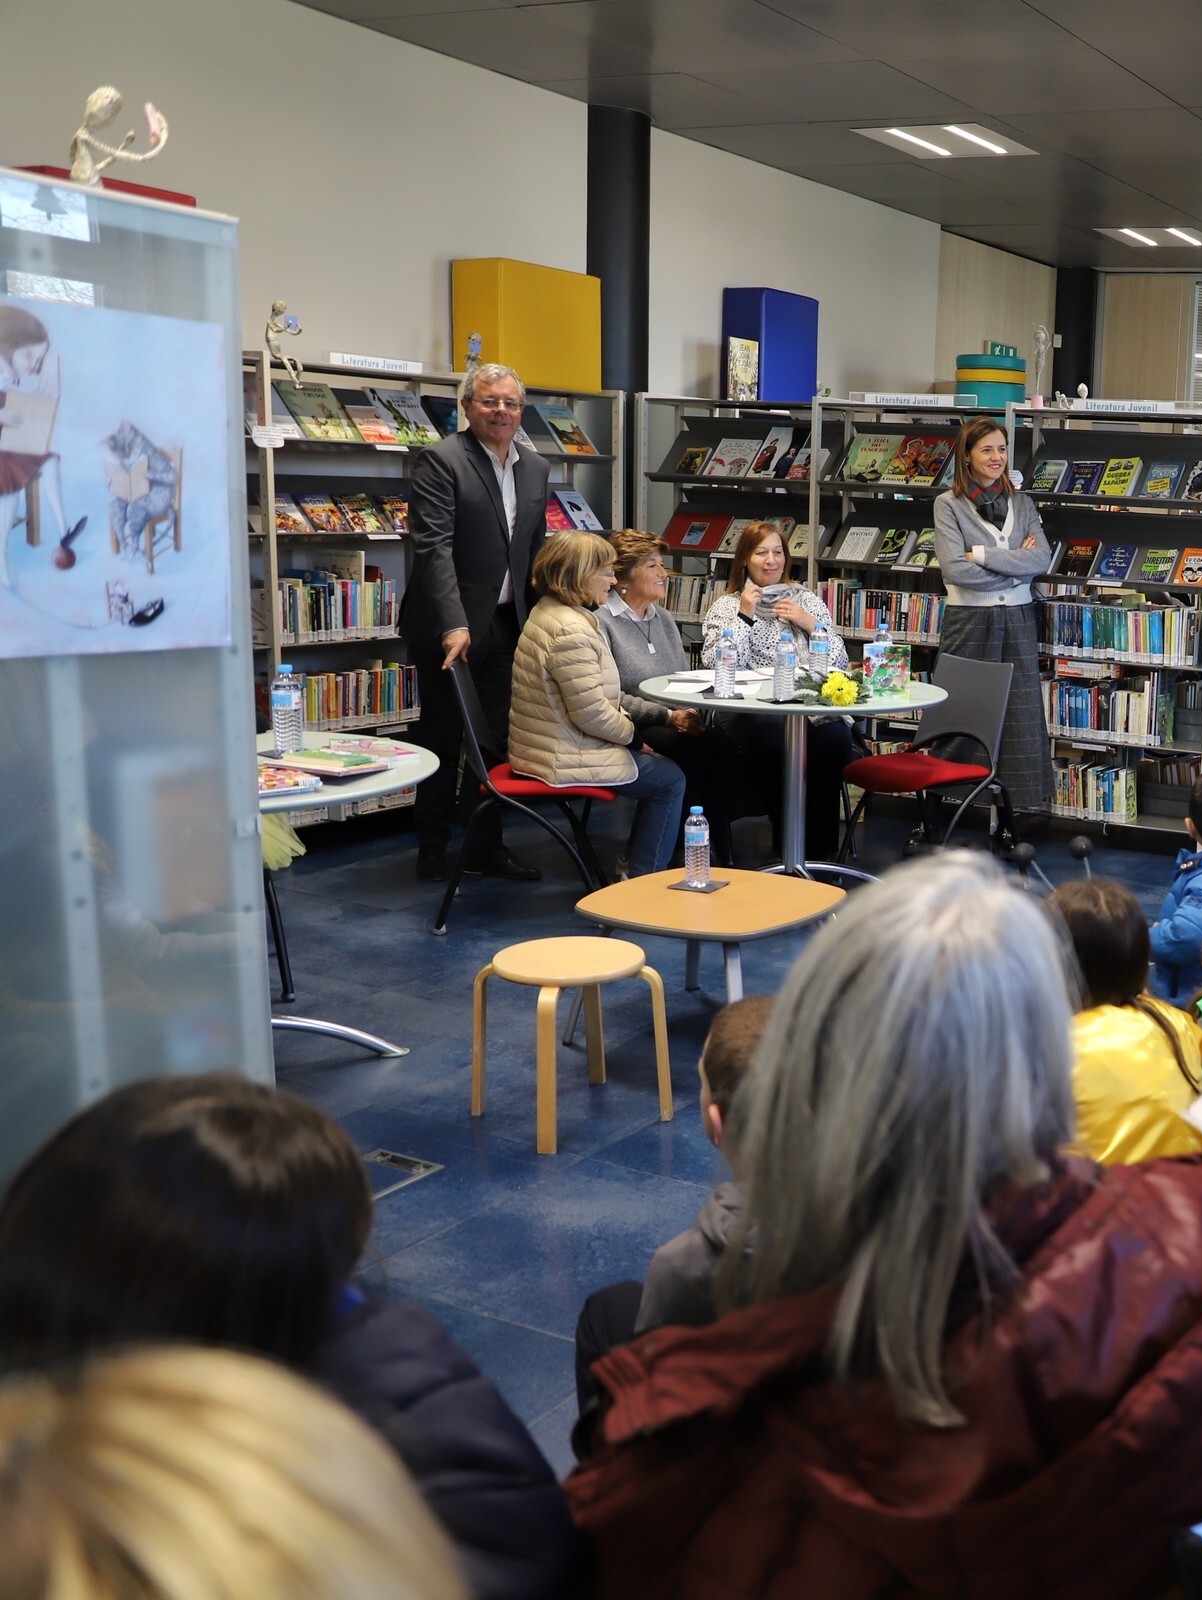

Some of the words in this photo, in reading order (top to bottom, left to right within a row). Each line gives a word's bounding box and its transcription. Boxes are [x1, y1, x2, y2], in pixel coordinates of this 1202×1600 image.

[341, 355, 379, 368] Literatura
[381, 359, 408, 371] Juvenil
[875, 395, 910, 405] Literatura
[912, 396, 939, 405] Juvenil
[1085, 401, 1126, 411] Literatura
[1128, 402, 1158, 413] Juvenil
[1106, 471, 1131, 479] GUERRA
[1144, 556, 1175, 564] DIREITOS
[1158, 563, 1171, 571] DAS
